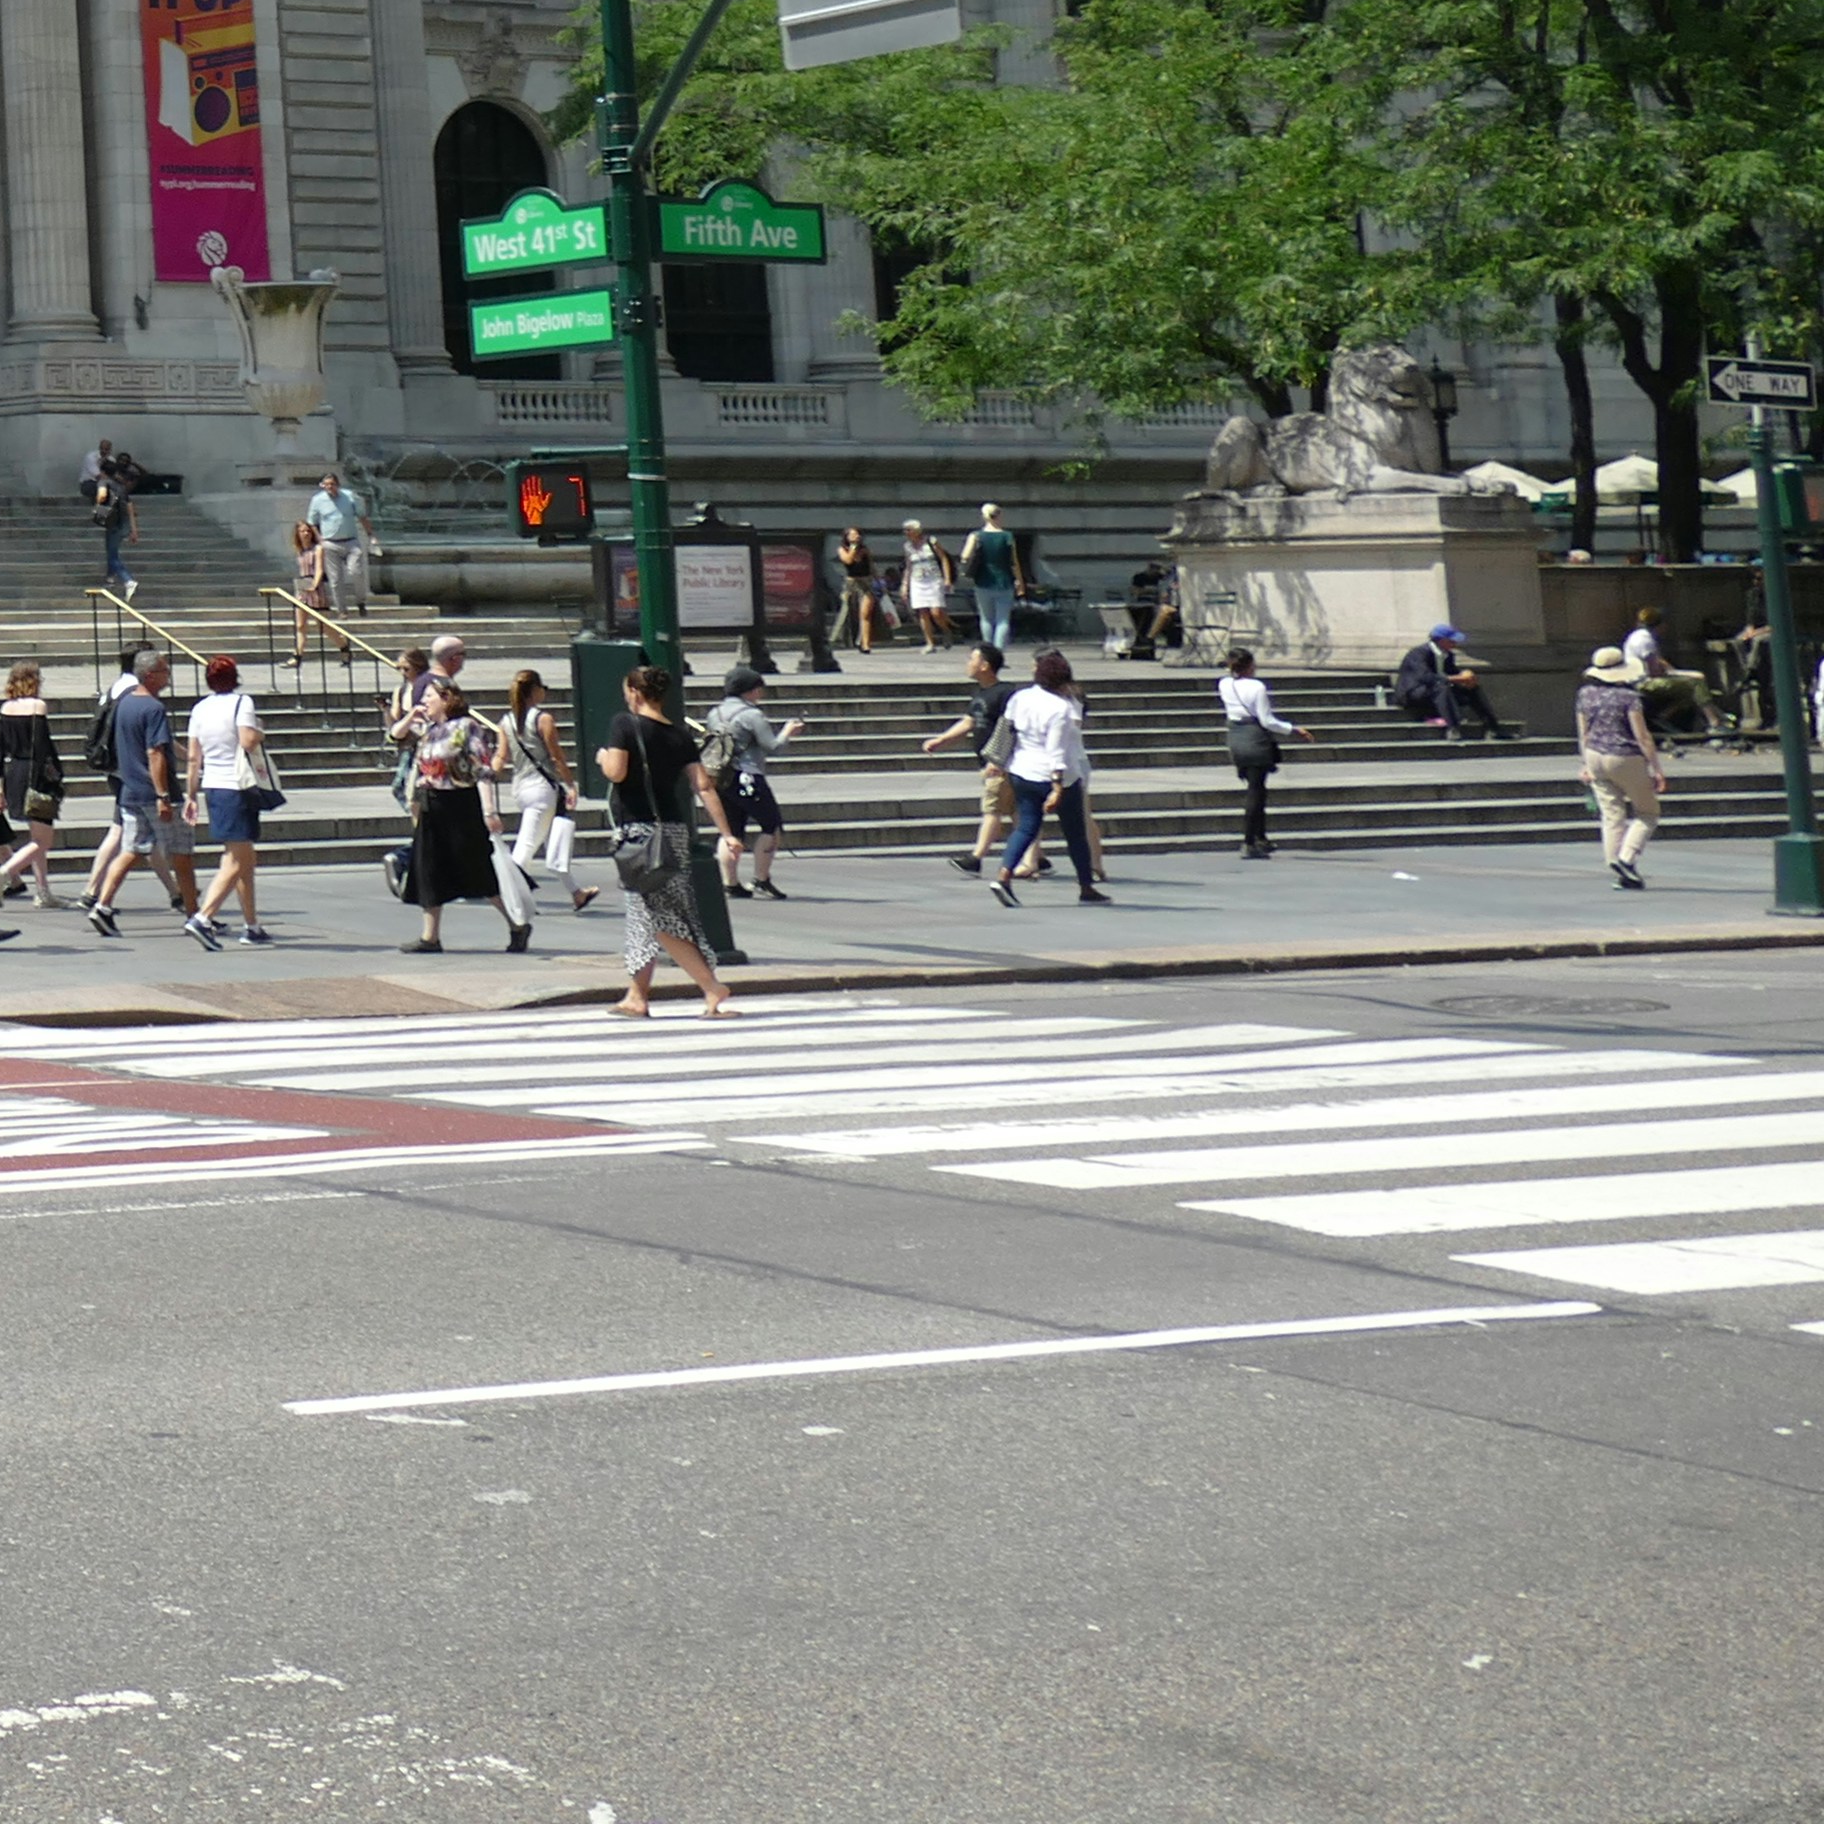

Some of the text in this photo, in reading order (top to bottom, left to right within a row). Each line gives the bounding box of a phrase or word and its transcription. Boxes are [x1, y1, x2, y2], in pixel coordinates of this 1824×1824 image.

[473, 219, 597, 264] West 41st St
[684, 214, 799, 249] Fifth Ave
[482, 309, 606, 339] John Bigelow Plaza
[1724, 373, 1801, 395] ONE WAY
[567, 475, 586, 517] 7
[681, 564, 745, 577] The New York
[683, 577, 746, 591] Public Library
